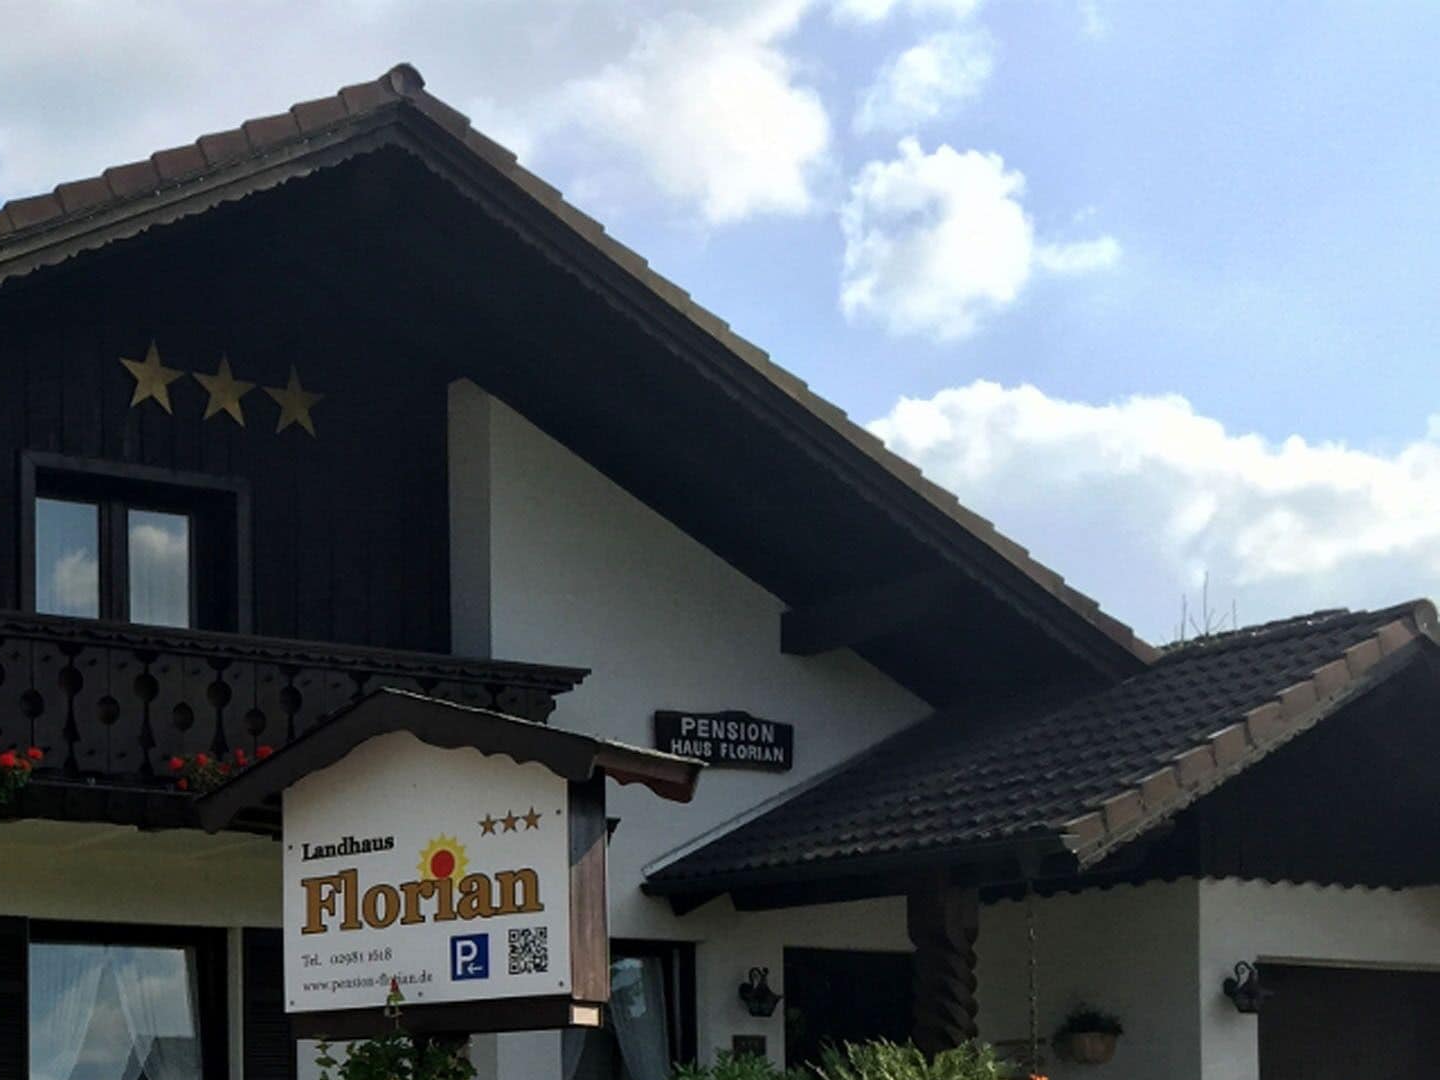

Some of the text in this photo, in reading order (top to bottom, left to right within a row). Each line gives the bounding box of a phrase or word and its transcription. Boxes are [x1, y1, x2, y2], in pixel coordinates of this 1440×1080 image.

[680, 716, 776, 744] PENSION
[671, 738, 786, 764] HAUS FLORIAN
[301, 836, 395, 863] Landhaus
[300, 867, 545, 935] Florian
[456, 940, 479, 976] P
